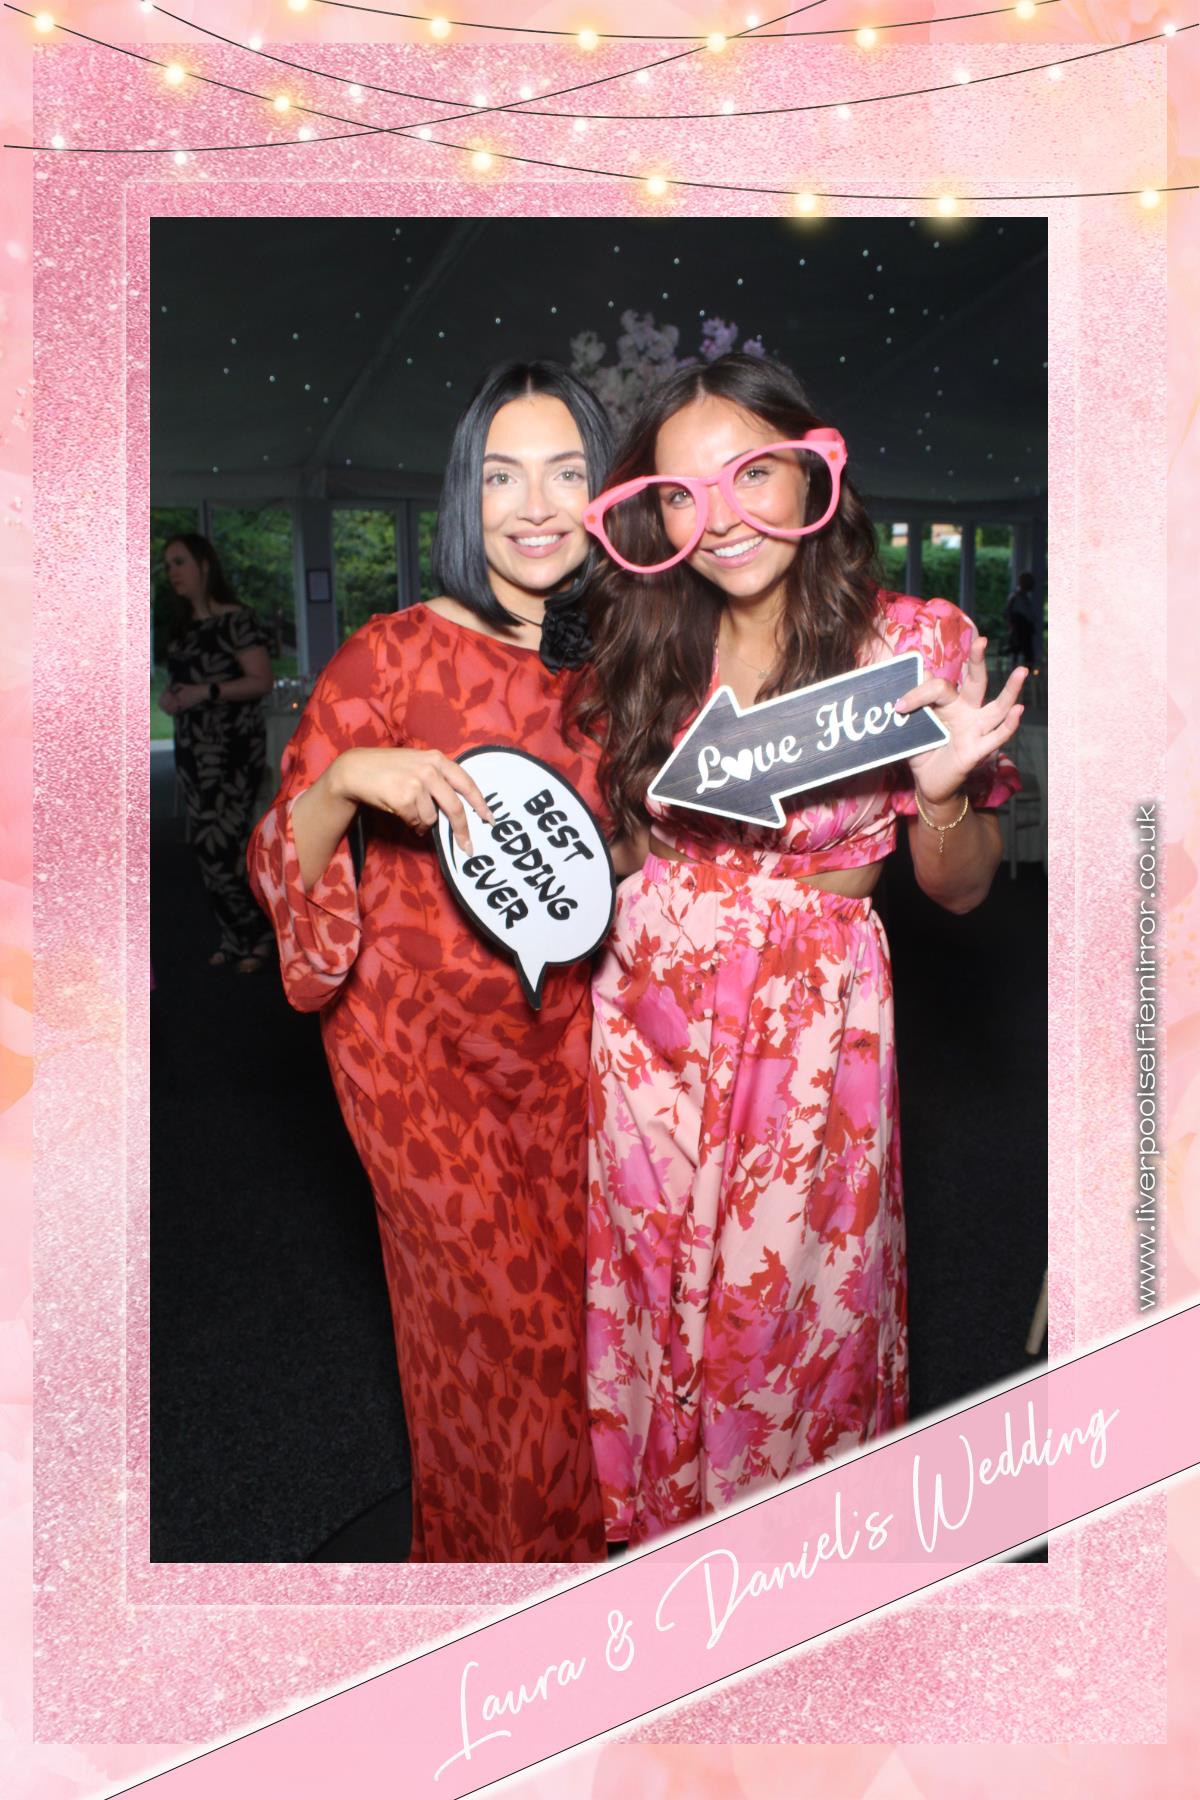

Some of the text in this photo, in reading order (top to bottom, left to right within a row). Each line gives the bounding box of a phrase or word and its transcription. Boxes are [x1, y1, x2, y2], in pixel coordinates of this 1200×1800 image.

[816, 696, 910, 751] Her
[523, 788, 595, 862] BEST
[462, 855, 529, 929] EVER
